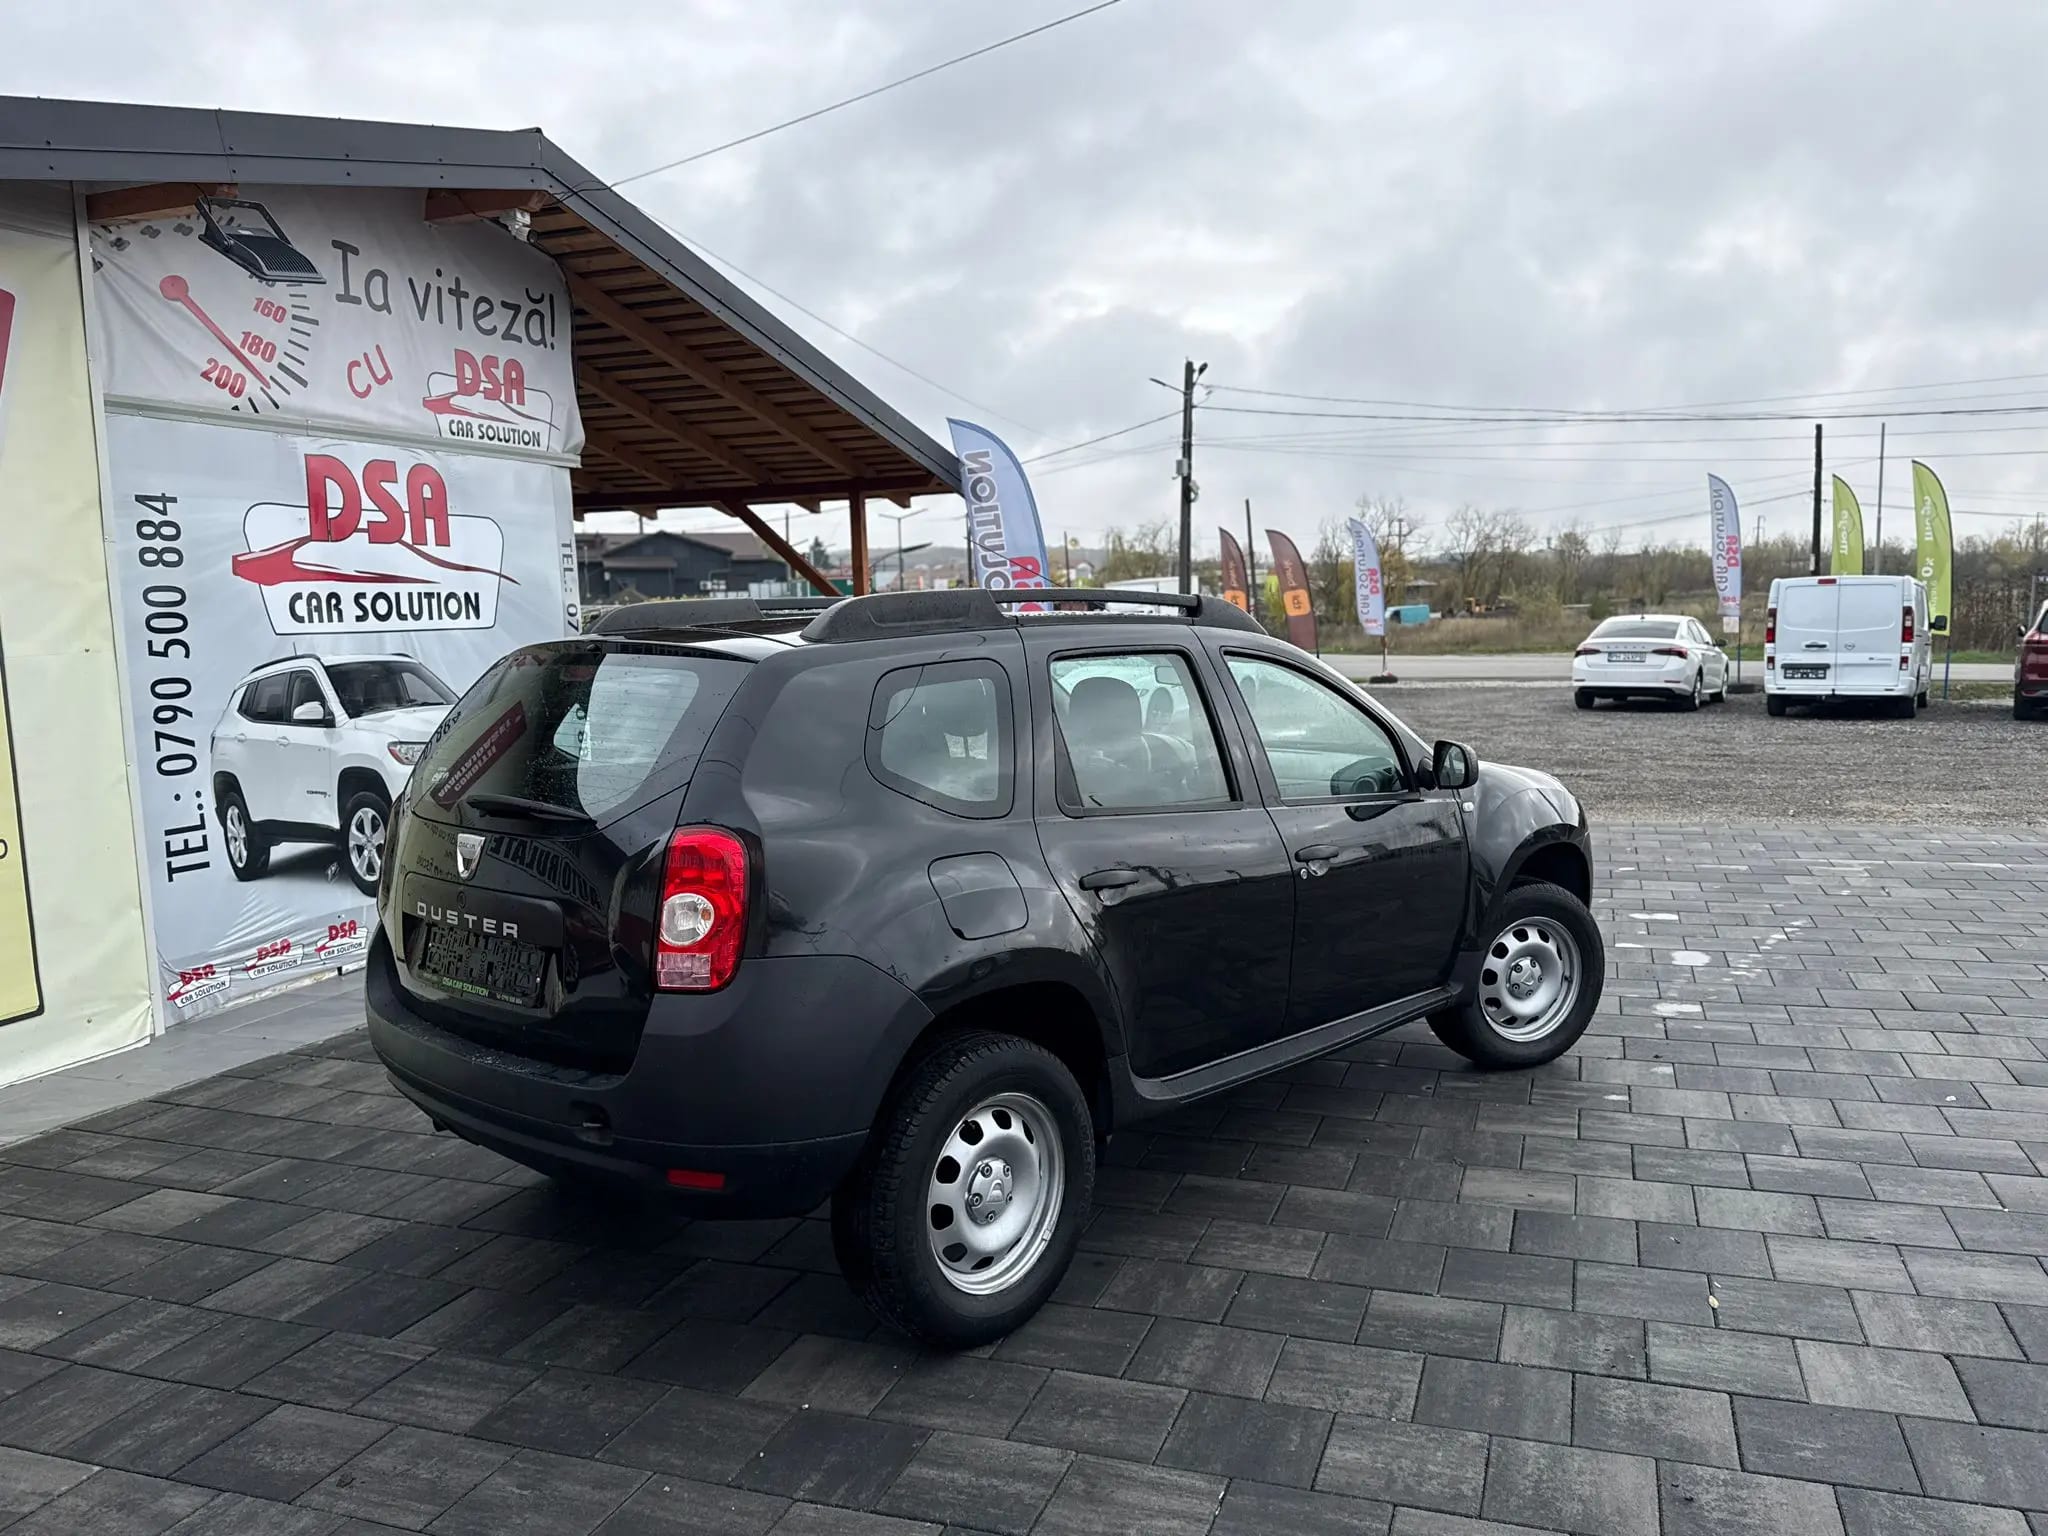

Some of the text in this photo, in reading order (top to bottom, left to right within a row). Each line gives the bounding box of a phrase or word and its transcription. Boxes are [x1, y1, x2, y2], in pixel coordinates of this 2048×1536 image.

[252, 297, 287, 324] 160
[331, 239, 556, 351] Ia viteză!
[239, 331, 277, 363] 180
[200, 357, 247, 399] 200
[347, 344, 393, 399] cu
[454, 348, 526, 406] DSA
[449, 419, 541, 448] CAR SOLUTION
[304, 453, 451, 547] DSA
[134, 492, 184, 568] 884
[142, 585, 191, 660] 500
[288, 591, 481, 624] CAR SOLUTION
[150, 676, 198, 777] 0790
[327, 919, 358, 942] DSA
[417, 902, 518, 938] DUSTER
[323, 941, 363, 957] CAR SOLUTION
[253, 959, 298, 977] CAR SOLUTION
[180, 980, 226, 1005] CAR SOLUTION
